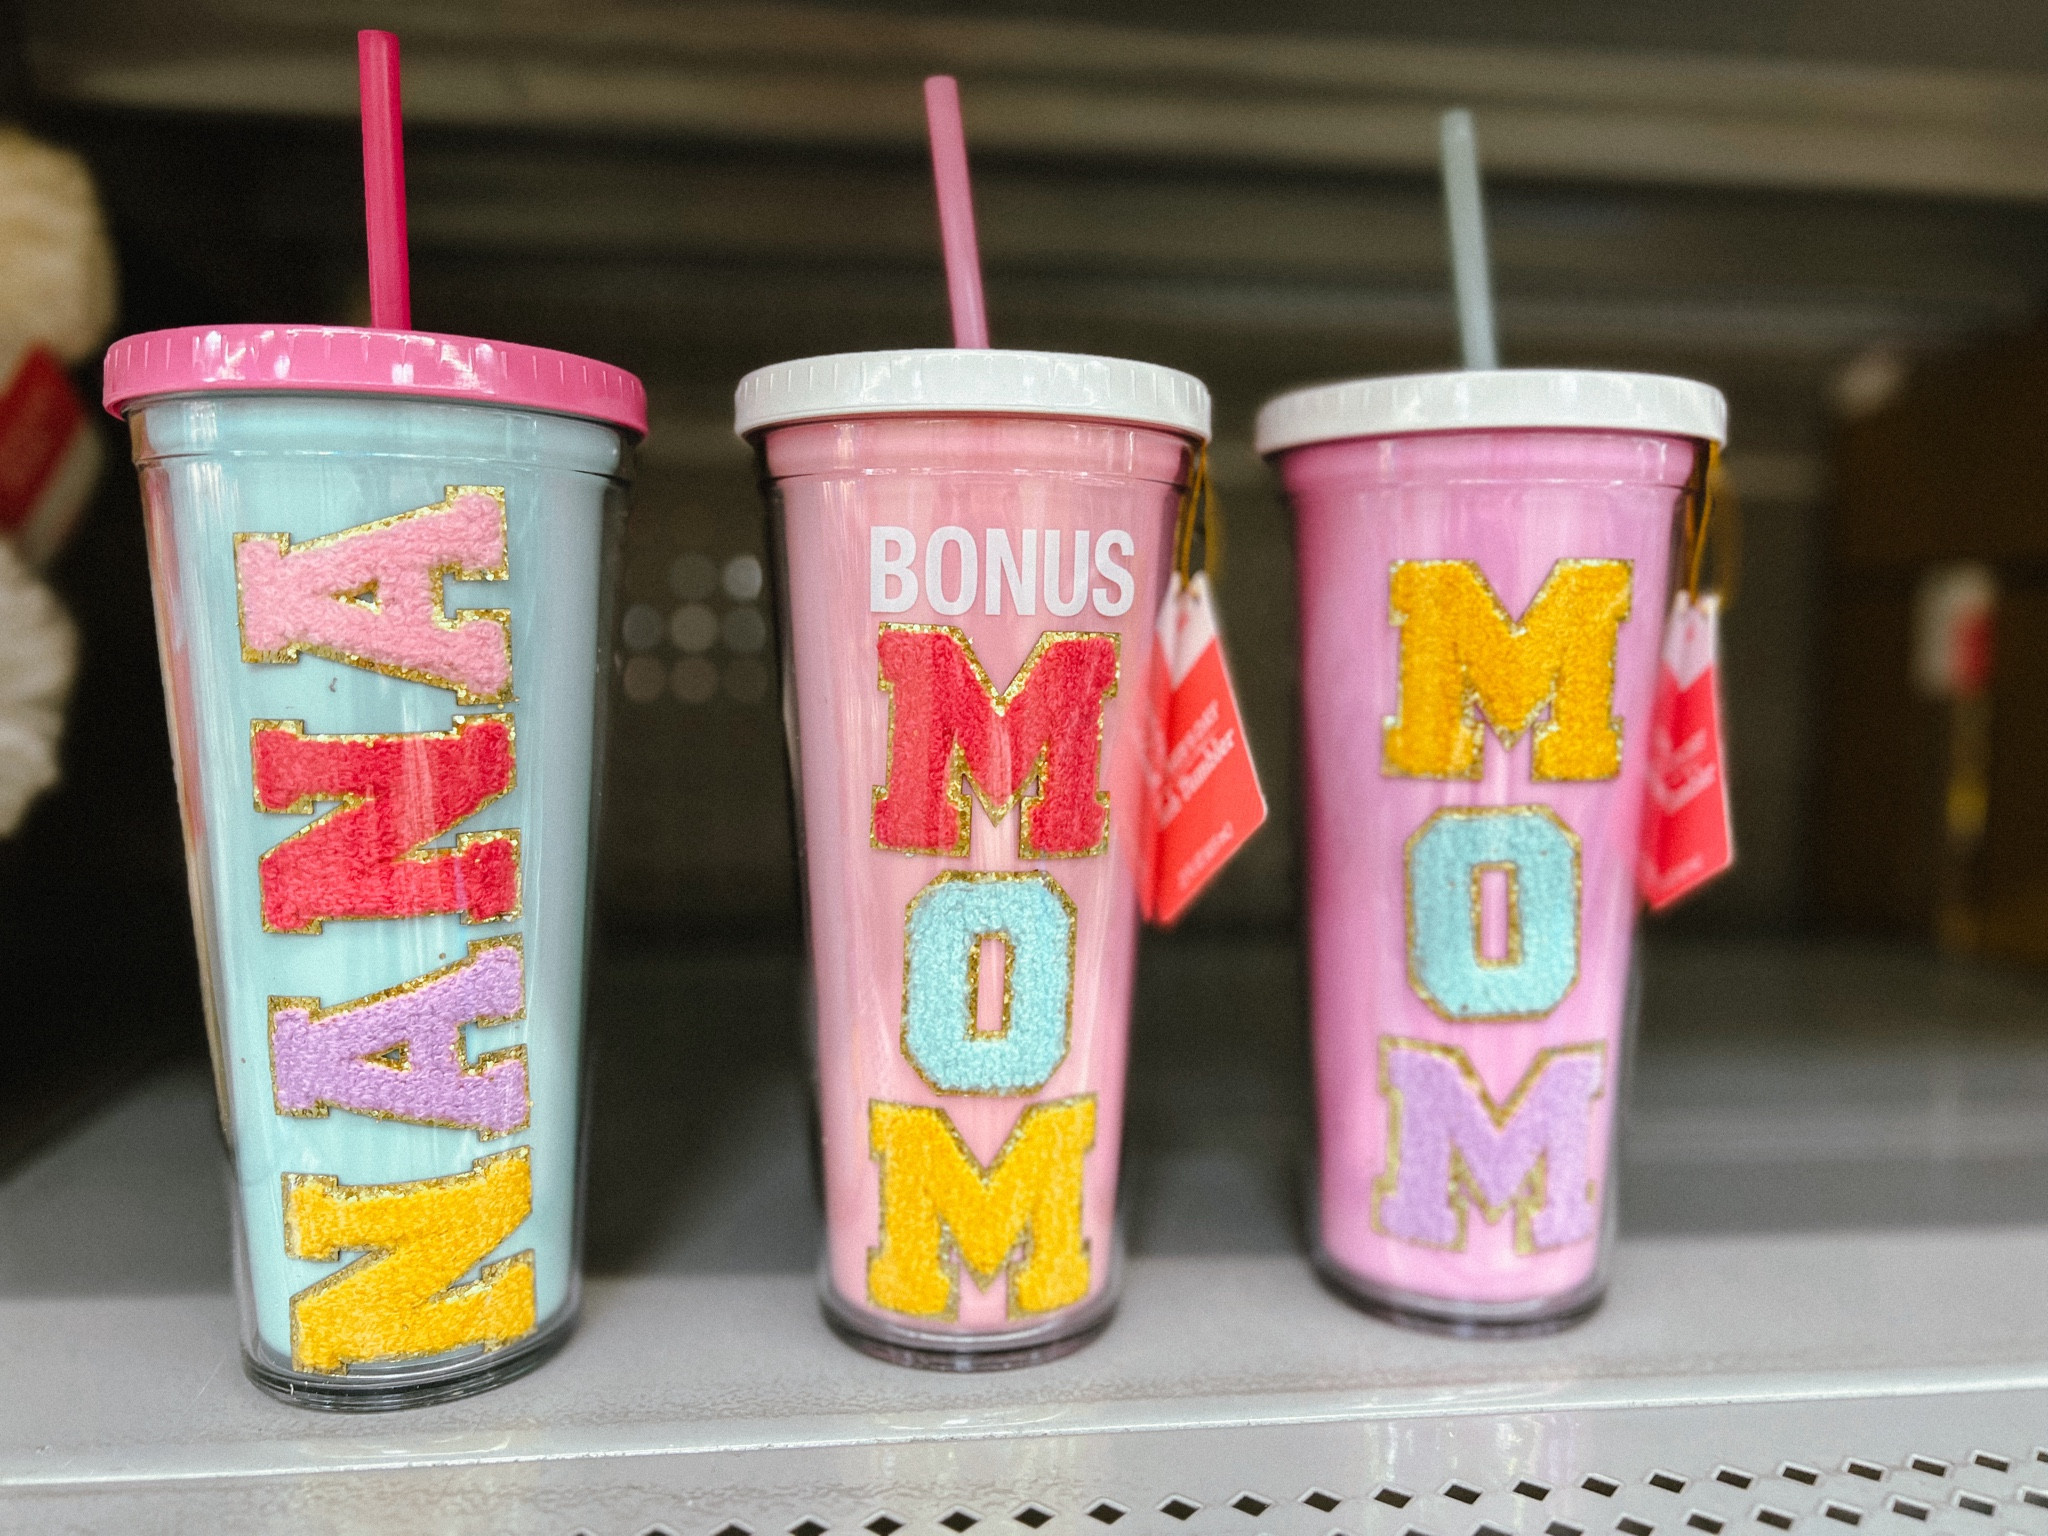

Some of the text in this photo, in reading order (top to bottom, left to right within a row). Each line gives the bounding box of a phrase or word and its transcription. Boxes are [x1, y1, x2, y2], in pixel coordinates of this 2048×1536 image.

[870, 526, 1136, 617] BONUS
[1370, 558, 1635, 1257] MOM
[234, 485, 538, 1376] NANA
[868, 622, 1122, 1322] MOM
